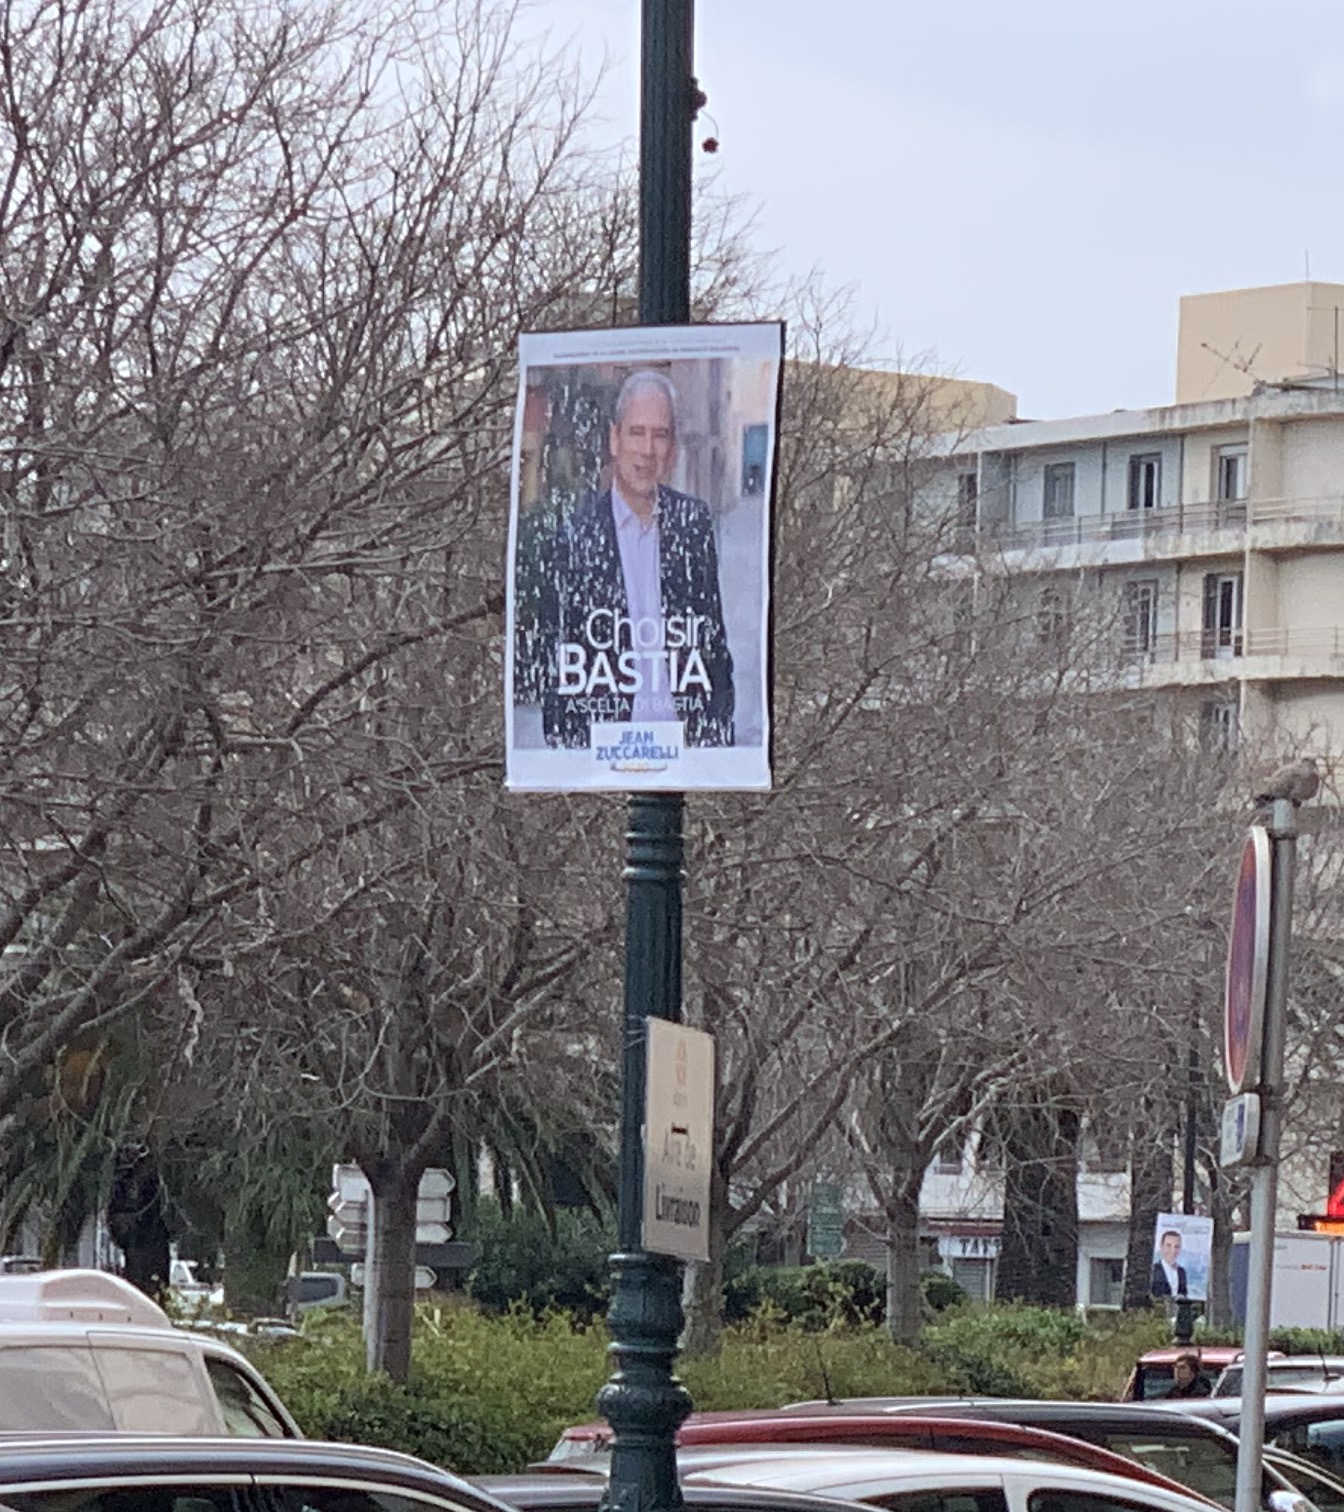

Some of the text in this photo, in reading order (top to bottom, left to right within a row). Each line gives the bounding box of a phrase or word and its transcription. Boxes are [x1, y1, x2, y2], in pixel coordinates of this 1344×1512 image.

[586, 607, 705, 651] Choisir
[558, 643, 713, 695] BASTIA
[619, 731, 654, 744] JEAN
[596, 746, 679, 760] ZUCCARELLI
